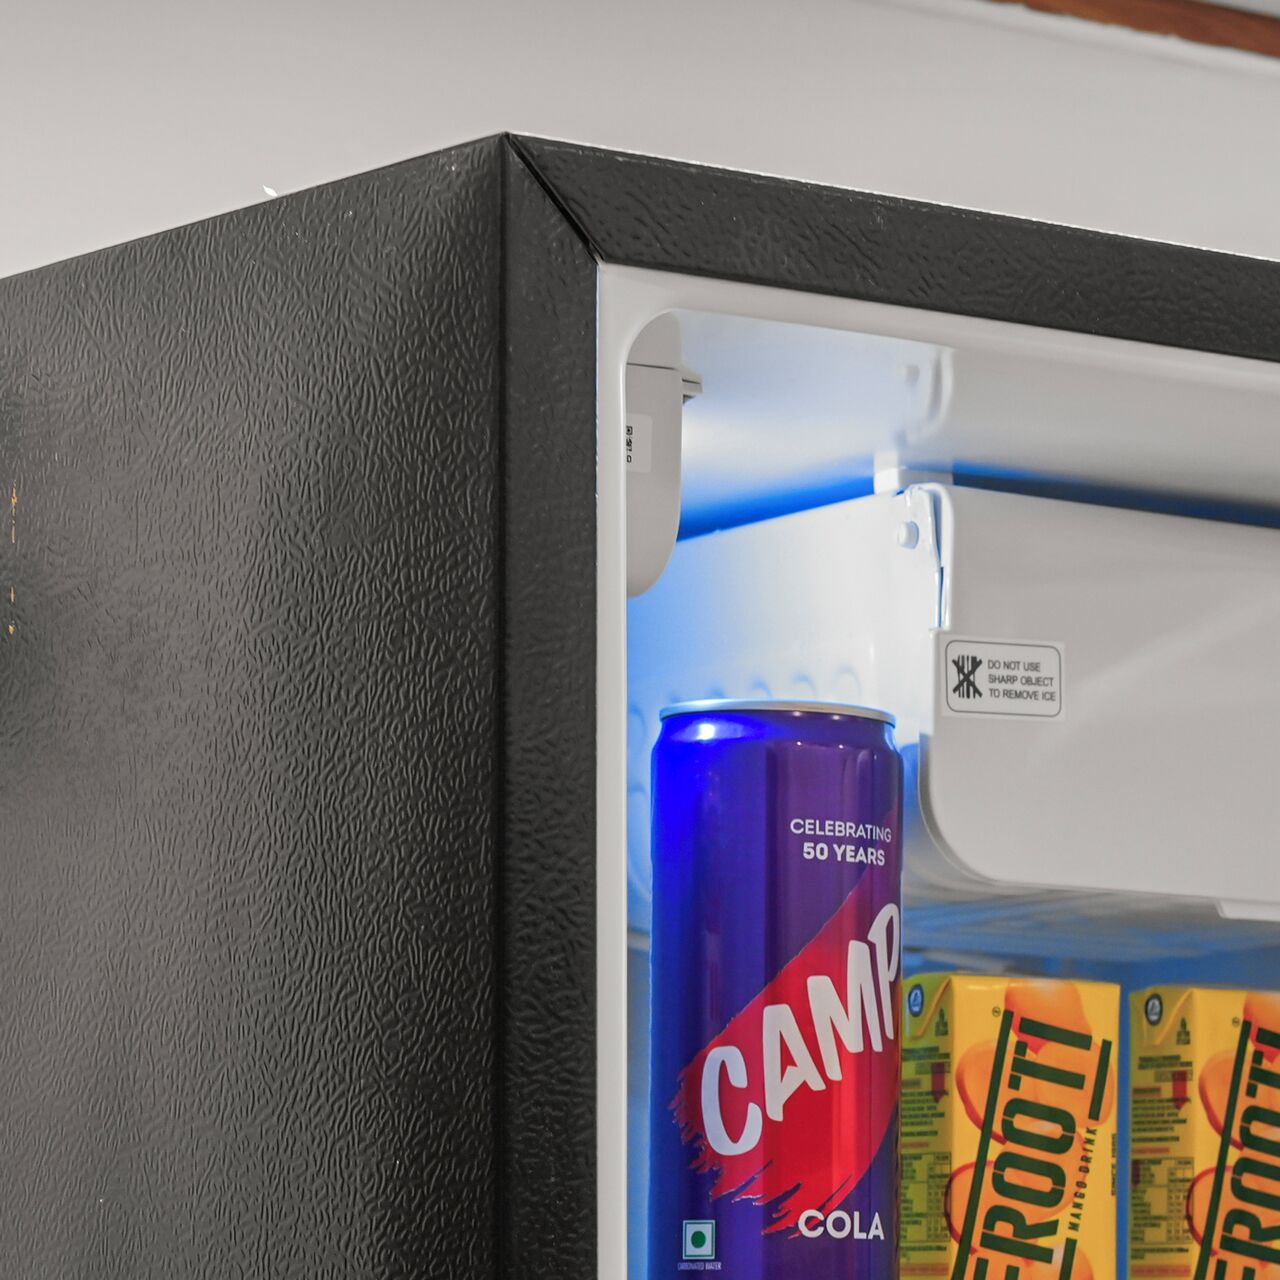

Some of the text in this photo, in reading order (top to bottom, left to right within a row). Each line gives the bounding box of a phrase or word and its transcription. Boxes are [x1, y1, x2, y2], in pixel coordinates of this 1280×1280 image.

[987, 659, 1041, 673] DO NOT USE
[988, 674, 1054, 687] SHARP OBJECT
[989, 688, 1056, 702] TO REMOVE ICE
[790, 817, 893, 844] CELEBRATING
[802, 841, 886, 867] 50 YEARS
[1067, 1126, 1098, 1233] MANGO DRINK
[798, 1209, 885, 1241] COLA
